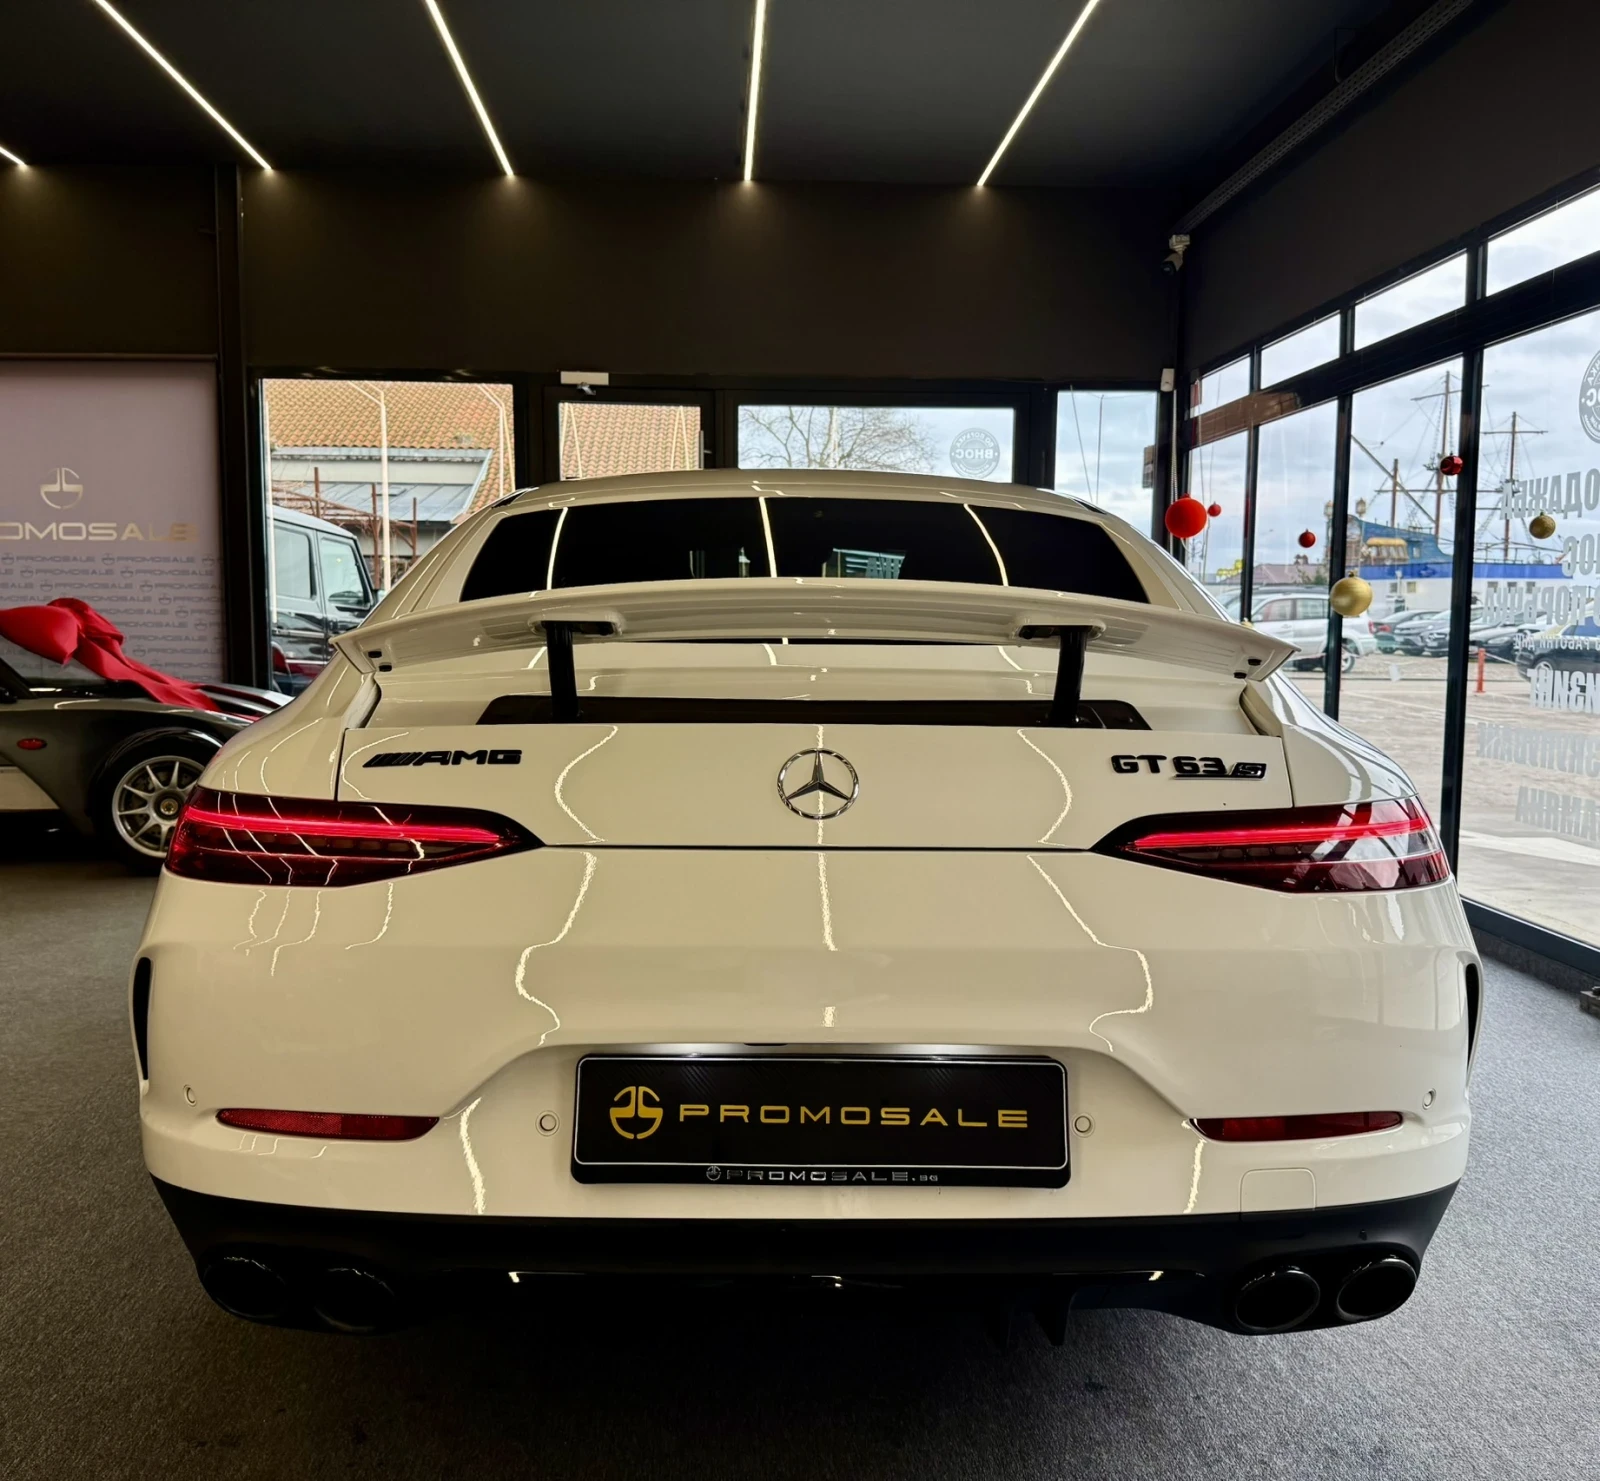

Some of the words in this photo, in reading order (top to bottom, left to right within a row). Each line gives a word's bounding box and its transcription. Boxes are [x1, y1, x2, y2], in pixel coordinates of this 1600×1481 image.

[412, 749, 523, 766] AMG
[1111, 754, 1167, 774] GT
[1172, 756, 1228, 775] 63
[1234, 763, 1266, 778] S
[679, 1104, 1028, 1128] PROMOSALE
